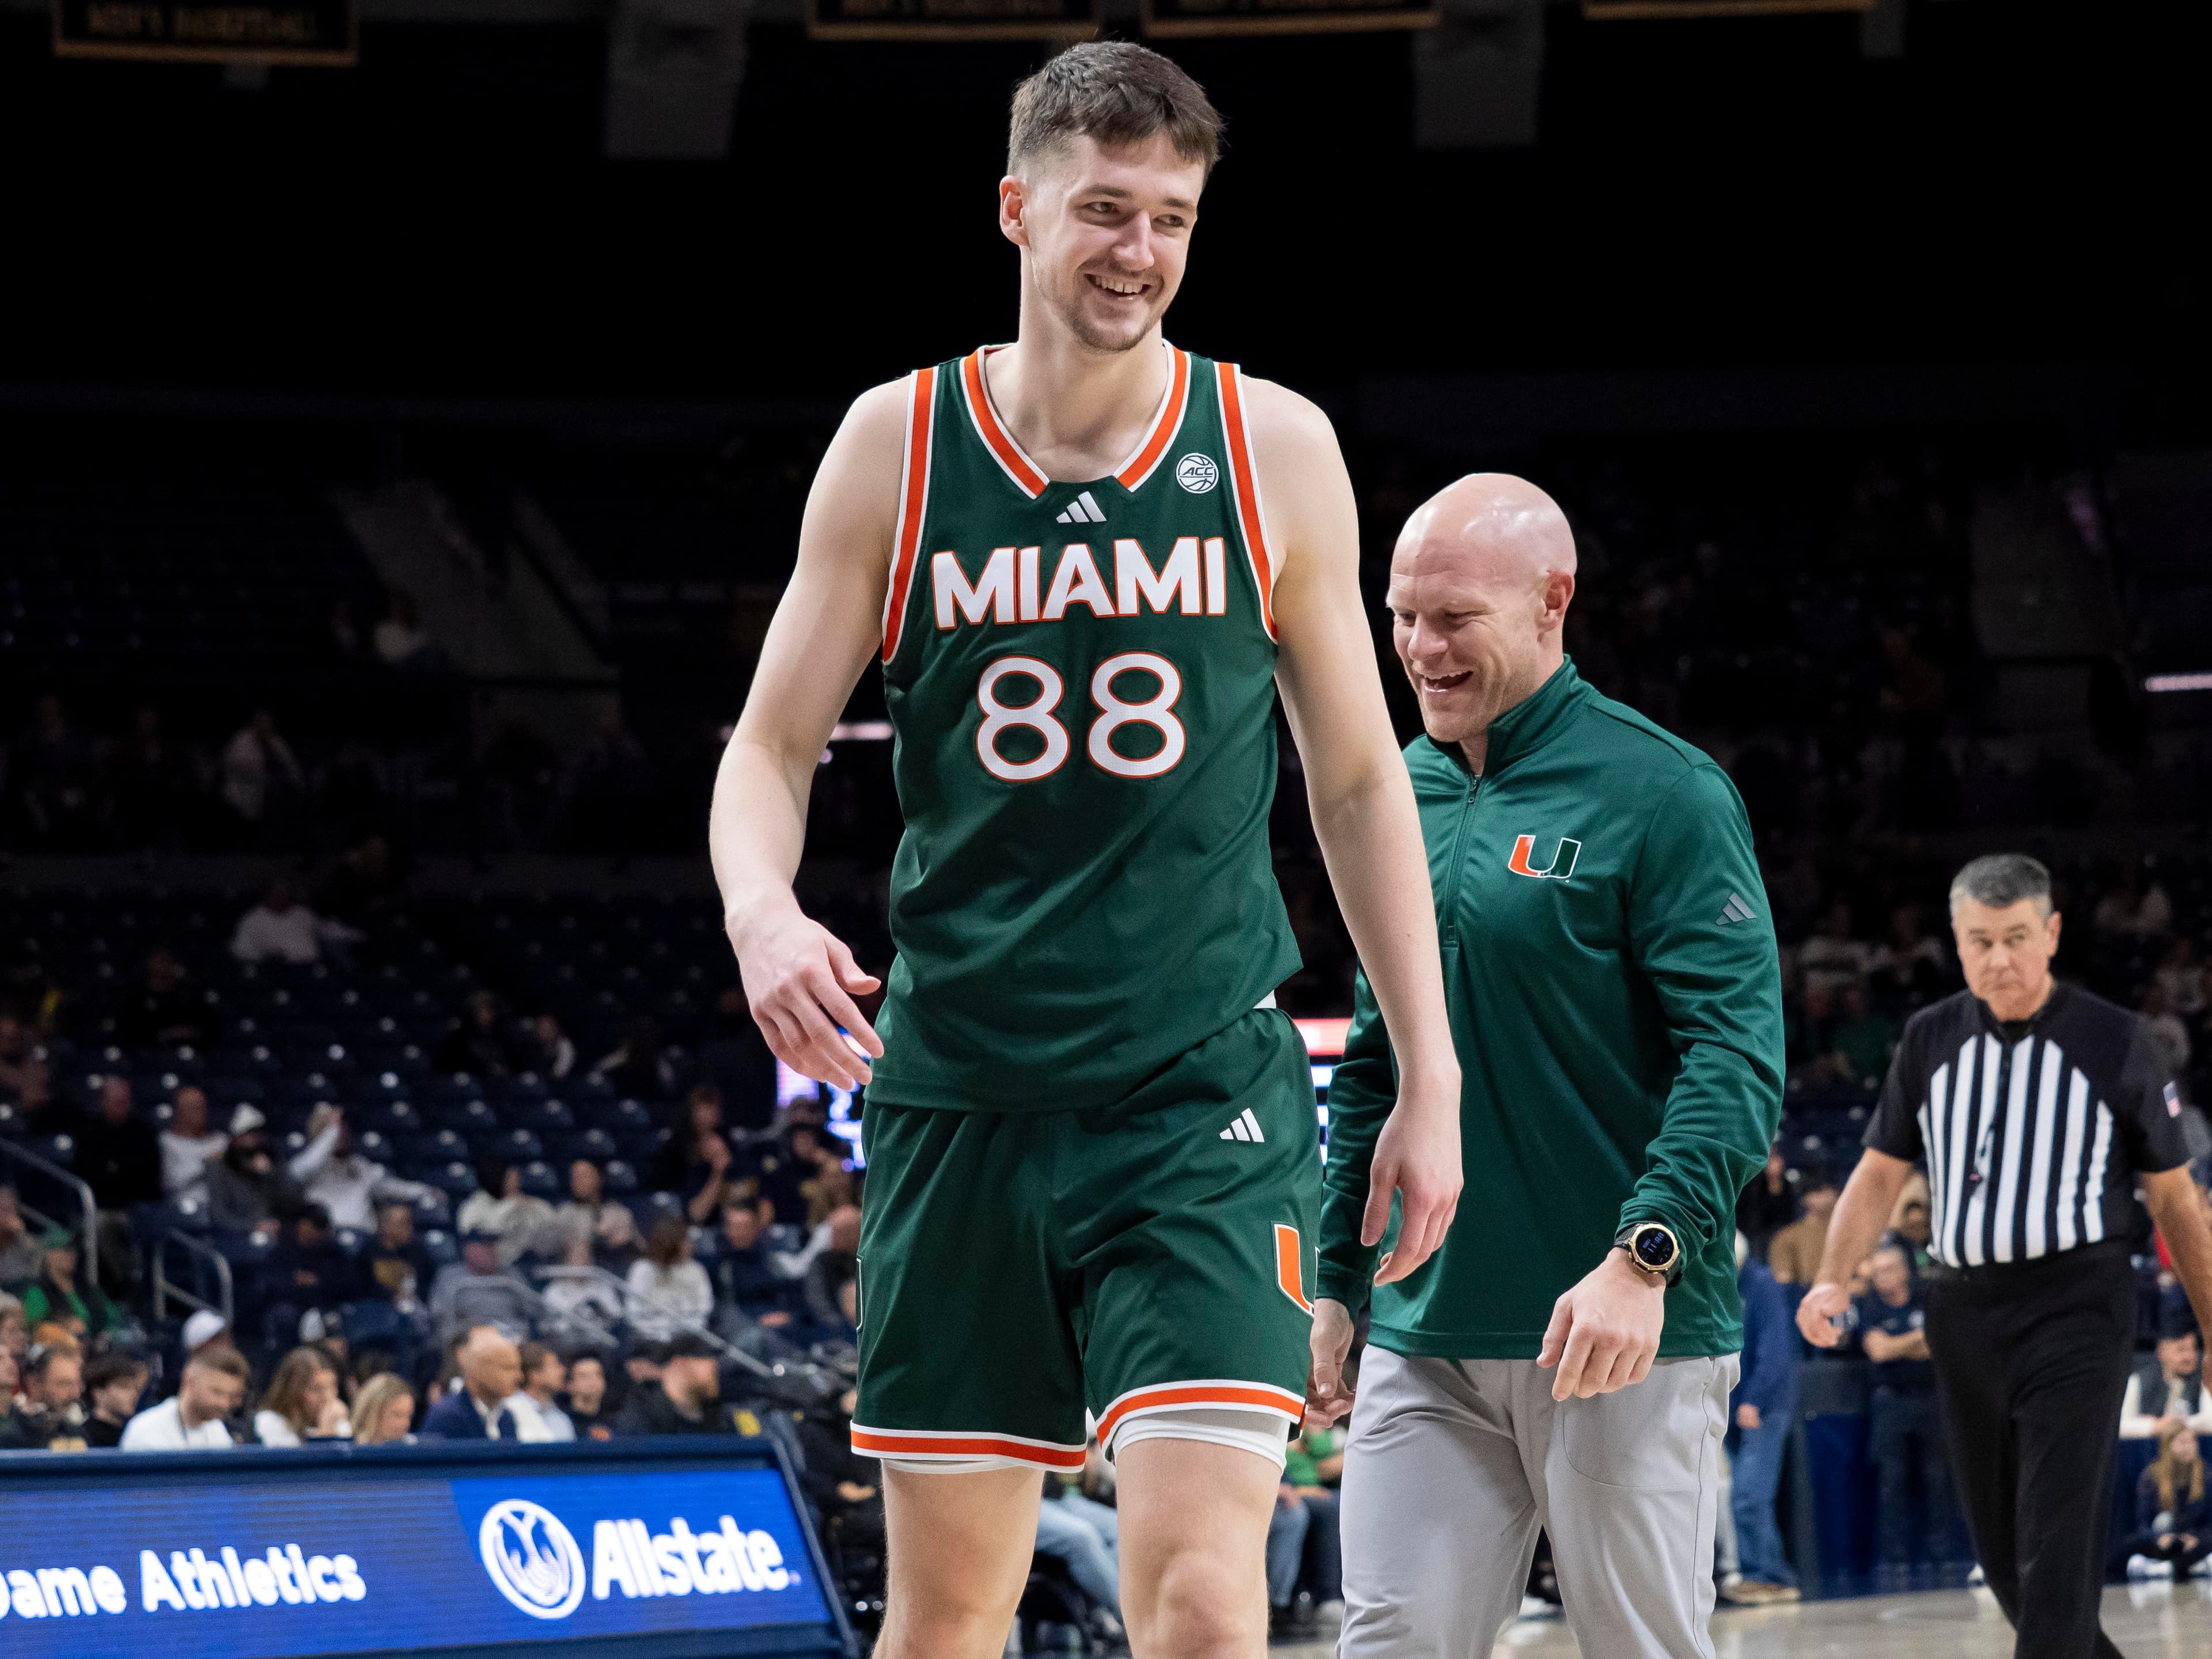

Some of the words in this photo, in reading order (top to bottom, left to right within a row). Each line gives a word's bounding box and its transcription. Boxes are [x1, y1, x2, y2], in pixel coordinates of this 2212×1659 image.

[1182, 467, 1215, 476] ACC
[931, 537, 1226, 630] MIAMI
[976, 652, 1185, 782] 88
[1508, 835, 1581, 879] U
[139, 1543, 367, 1613] Athletics
[592, 1515, 790, 1600] Allstate
